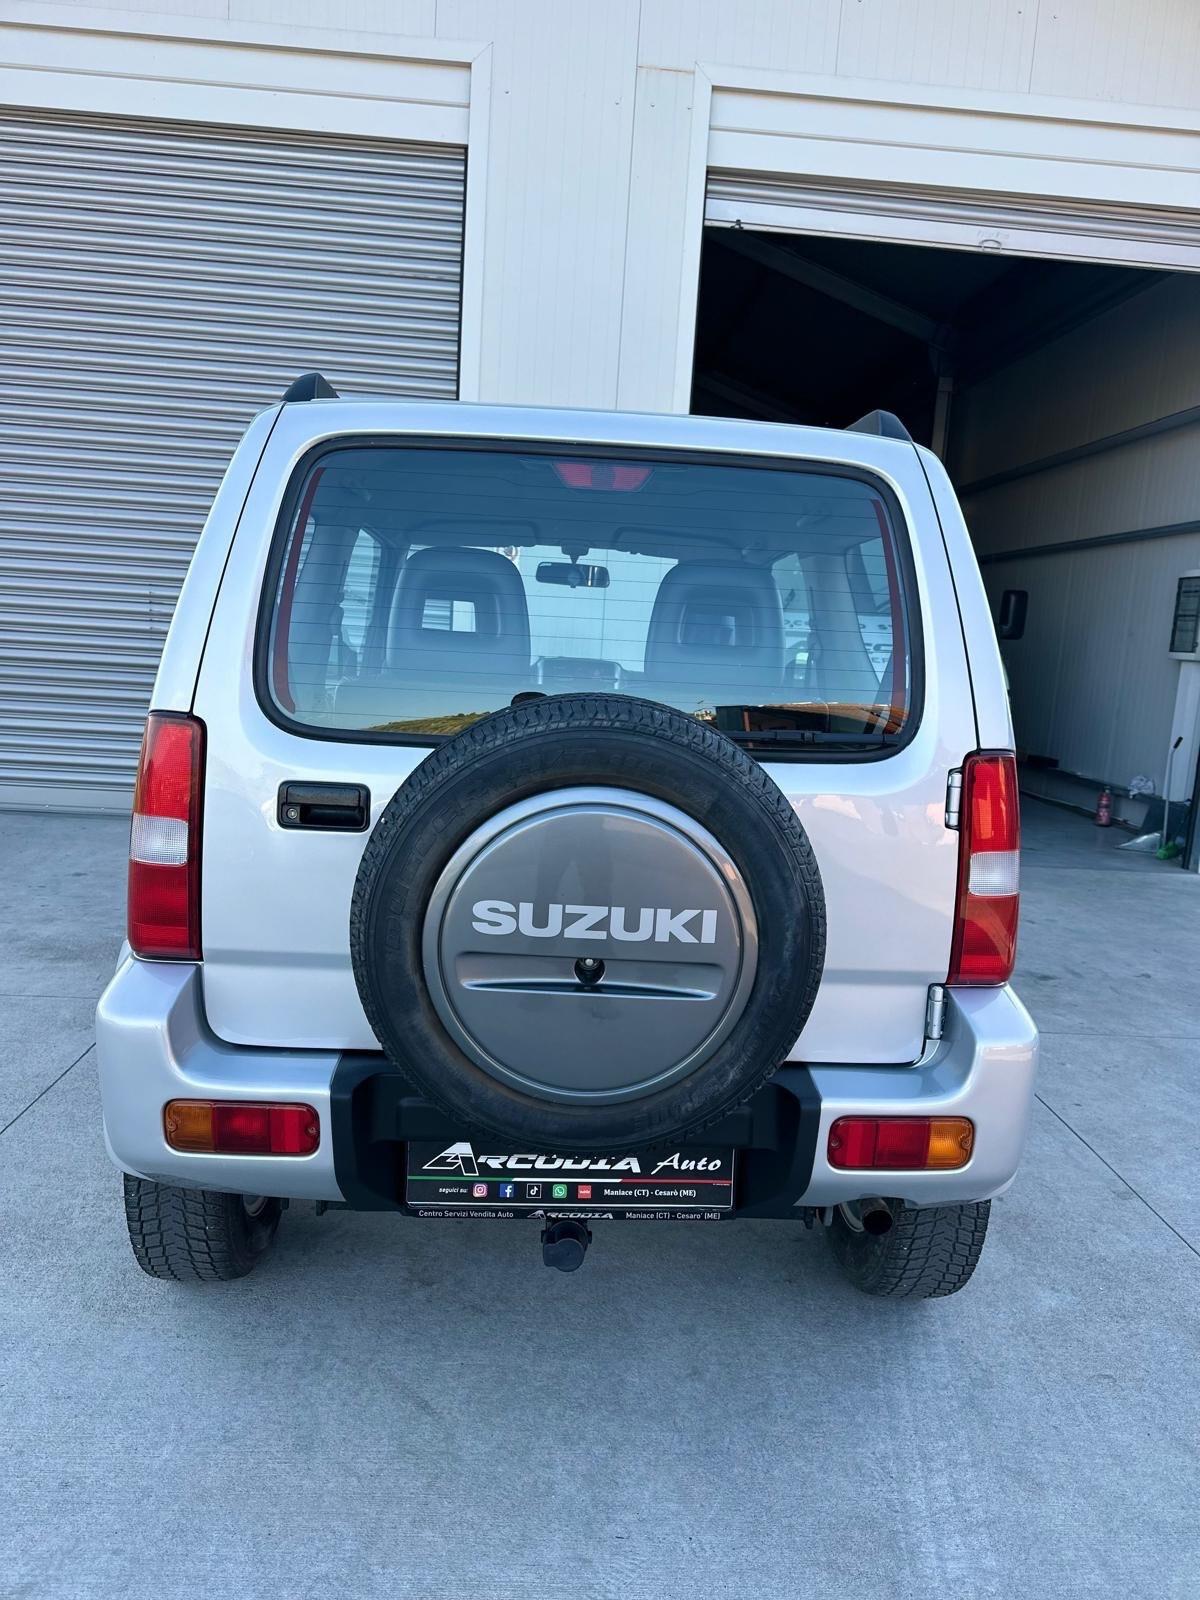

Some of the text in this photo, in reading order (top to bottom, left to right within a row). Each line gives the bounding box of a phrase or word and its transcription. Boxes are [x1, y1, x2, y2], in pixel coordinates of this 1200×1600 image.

[471, 899, 718, 944] SUZUKI
[422, 1142, 722, 1176] ARCODIA Auto
[603, 1188, 633, 1196] Maniace
[634, 1188, 649, 1198] (CT)
[655, 1188, 678, 1197] Cesarò
[679, 1189, 697, 1198] (ME)
[419, 1209, 443, 1218] Centro
[444, 1210, 468, 1218] Servizi
[469, 1210, 496, 1218] Vendita
[497, 1211, 514, 1219] Auto
[527, 1209, 614, 1220] ARCODIA
[625, 1211, 655, 1219] Maniace
[656, 1211, 671, 1220] (CT)
[704, 1212, 721, 1221] (ME)
